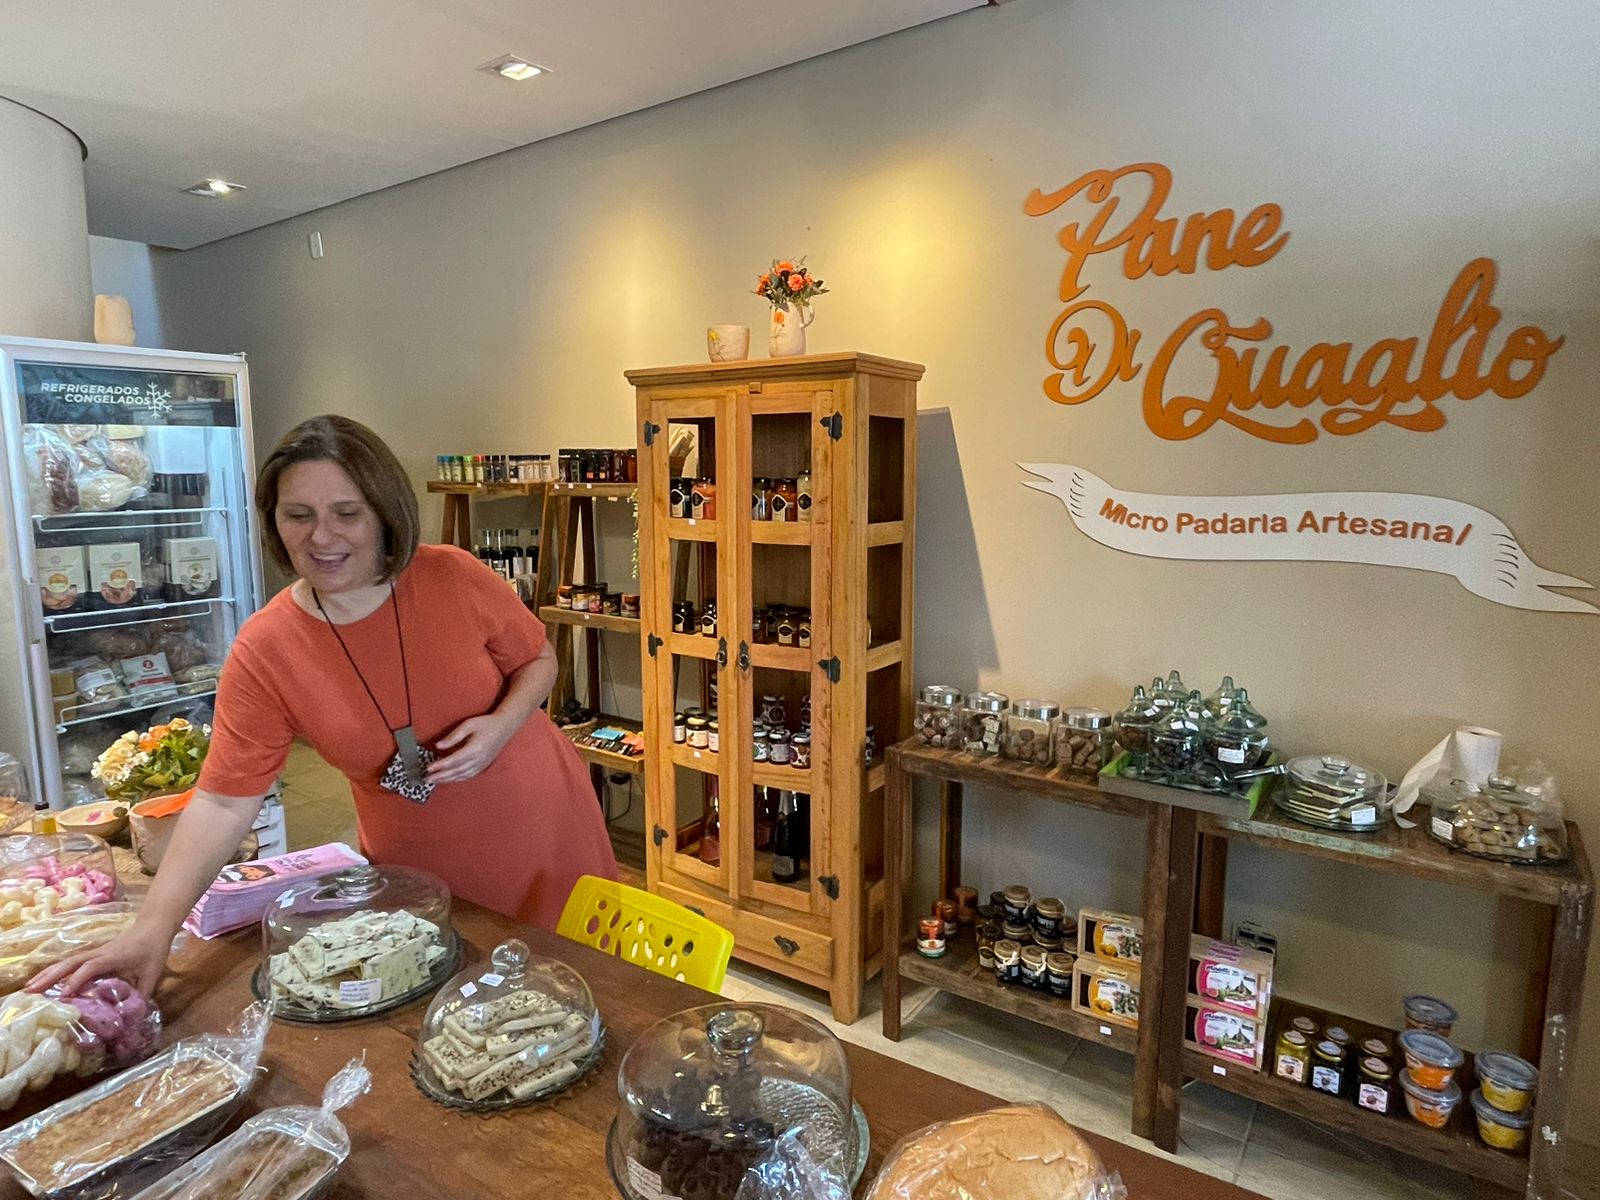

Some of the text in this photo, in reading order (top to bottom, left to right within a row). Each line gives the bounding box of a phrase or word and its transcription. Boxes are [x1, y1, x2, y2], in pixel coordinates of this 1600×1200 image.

[1024, 162, 1291, 302] Pane
[1043, 257, 1564, 444] Di Quaglio
[40, 383, 140, 396] REFRIGERADOS
[64, 393, 151, 405] CONGELADOS
[1099, 498, 1473, 546] Micro Padaria Artesanal
